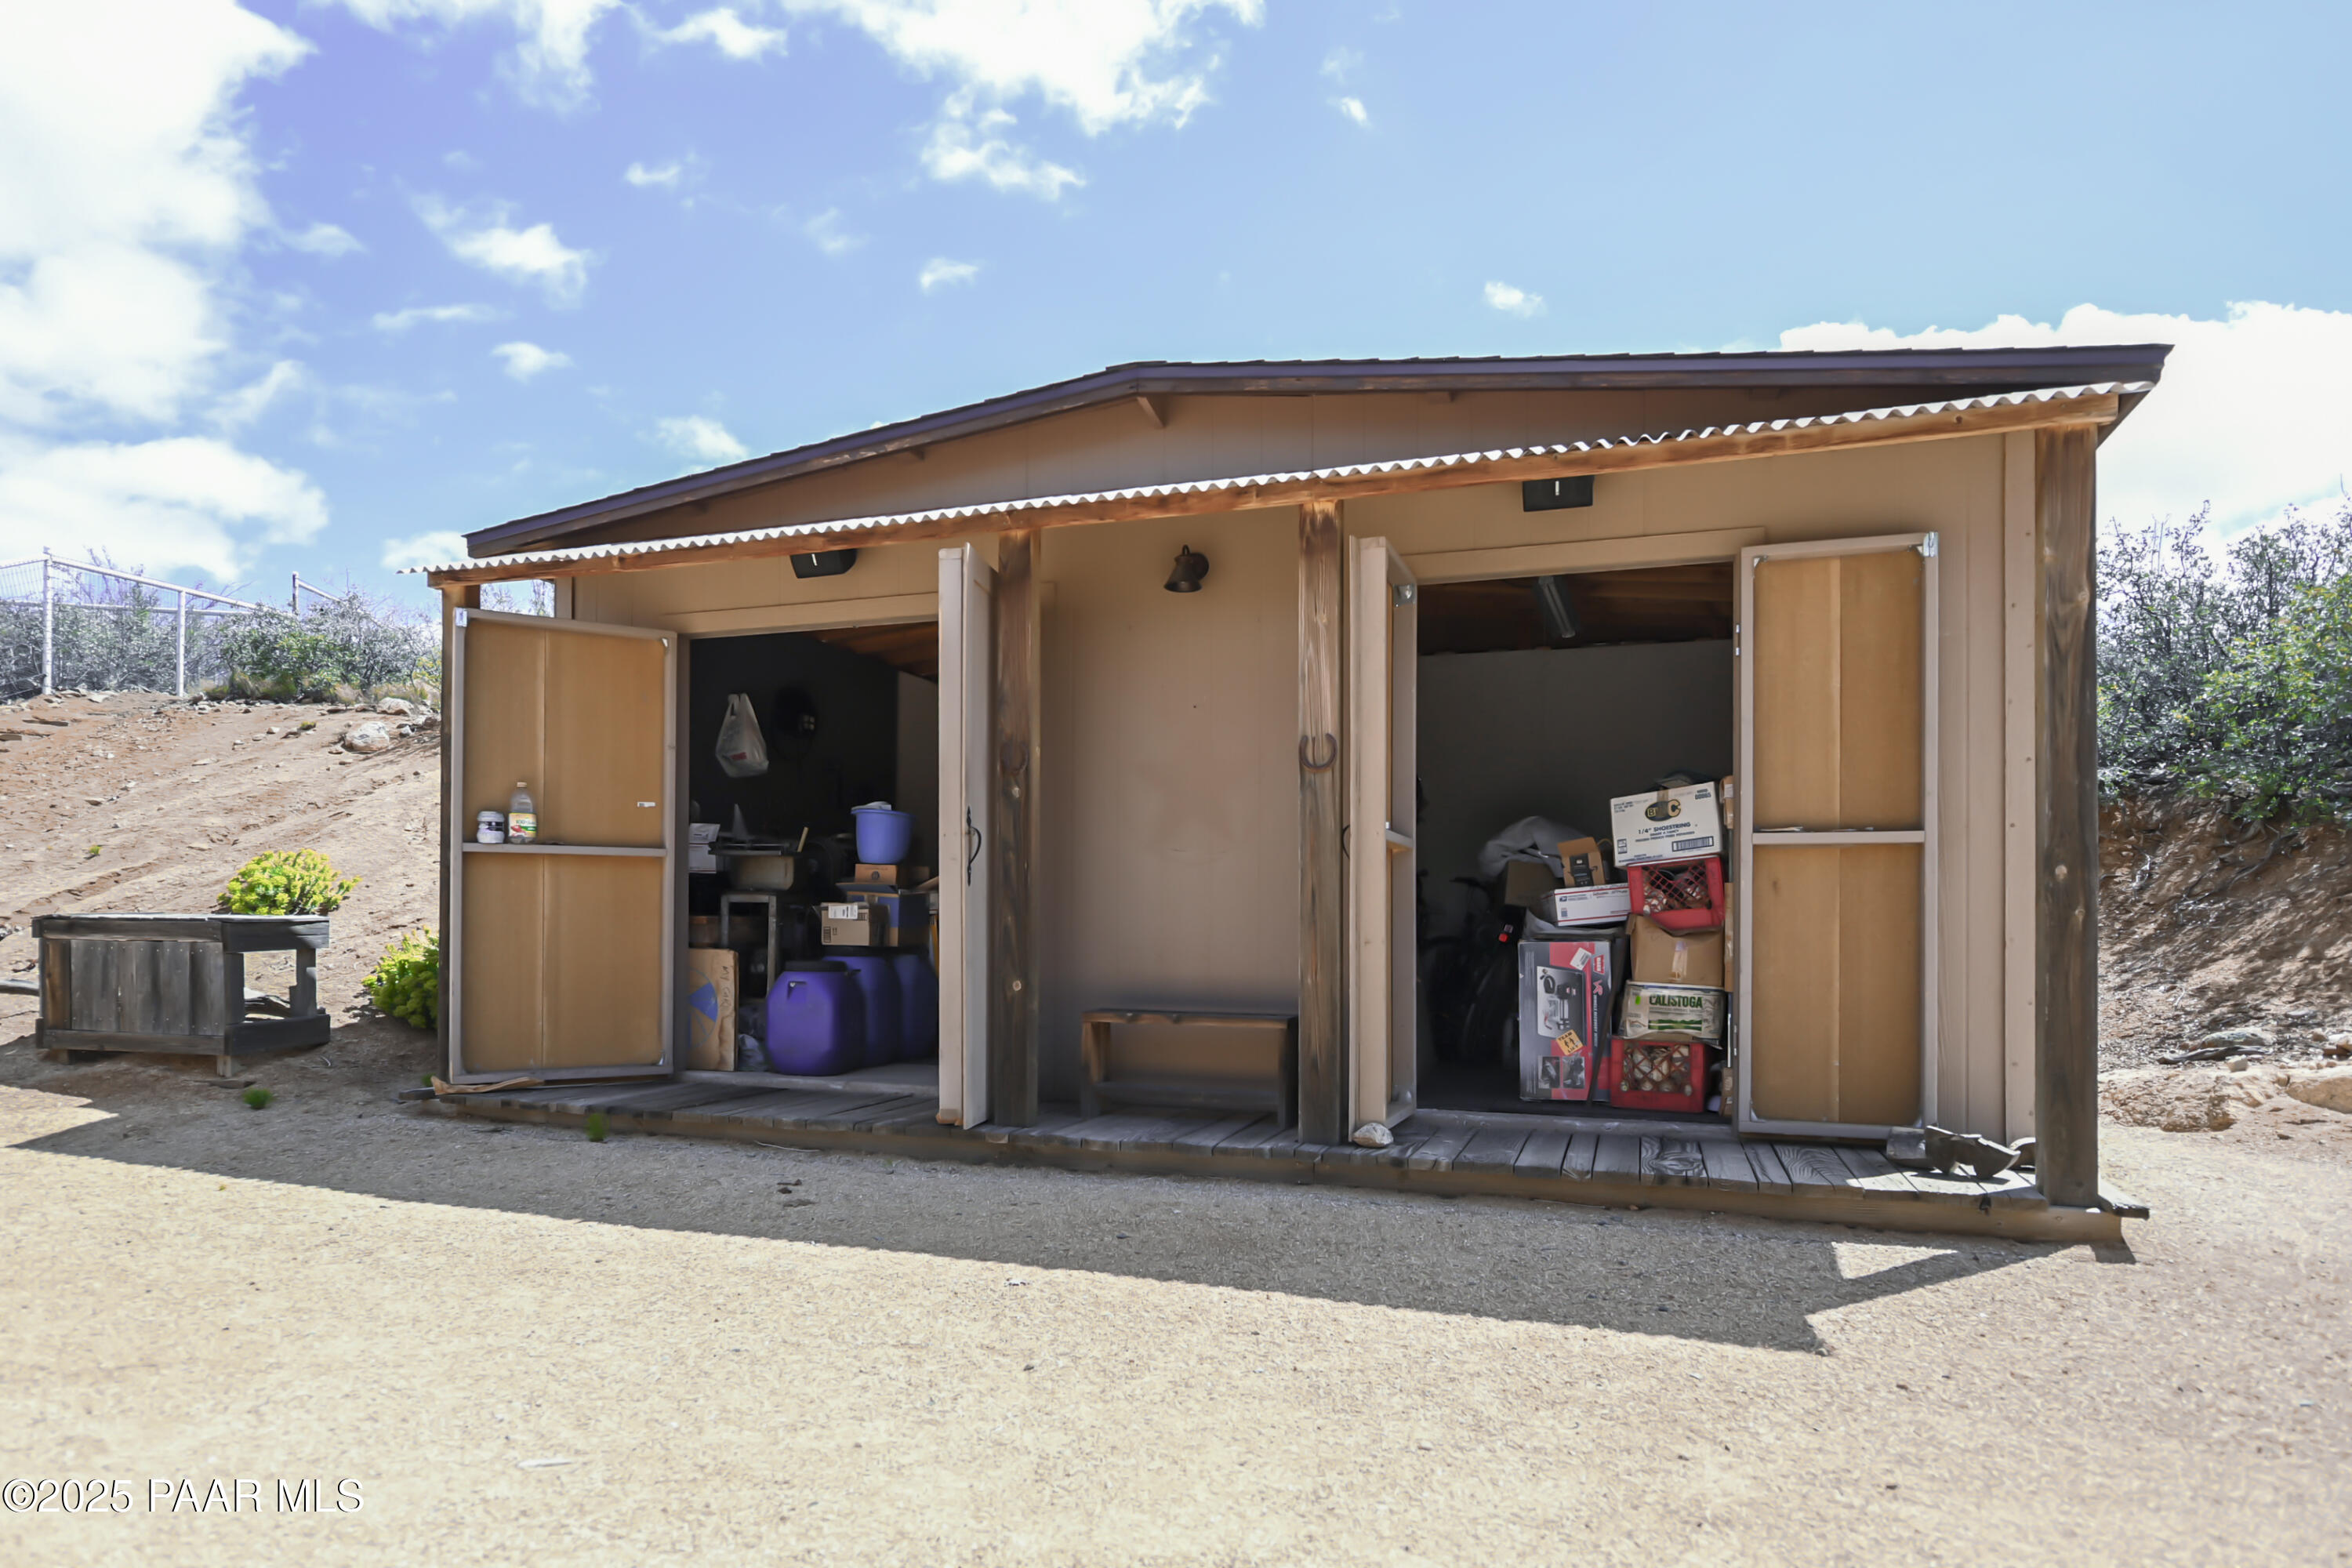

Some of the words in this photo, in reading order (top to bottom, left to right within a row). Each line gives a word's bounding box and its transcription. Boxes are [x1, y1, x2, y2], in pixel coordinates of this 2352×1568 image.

[1653, 822, 1691, 831] SHOESTRING
[1649, 994, 1703, 1008] CALISTOGA
[1558, 1031, 1573, 1041] TEAM
